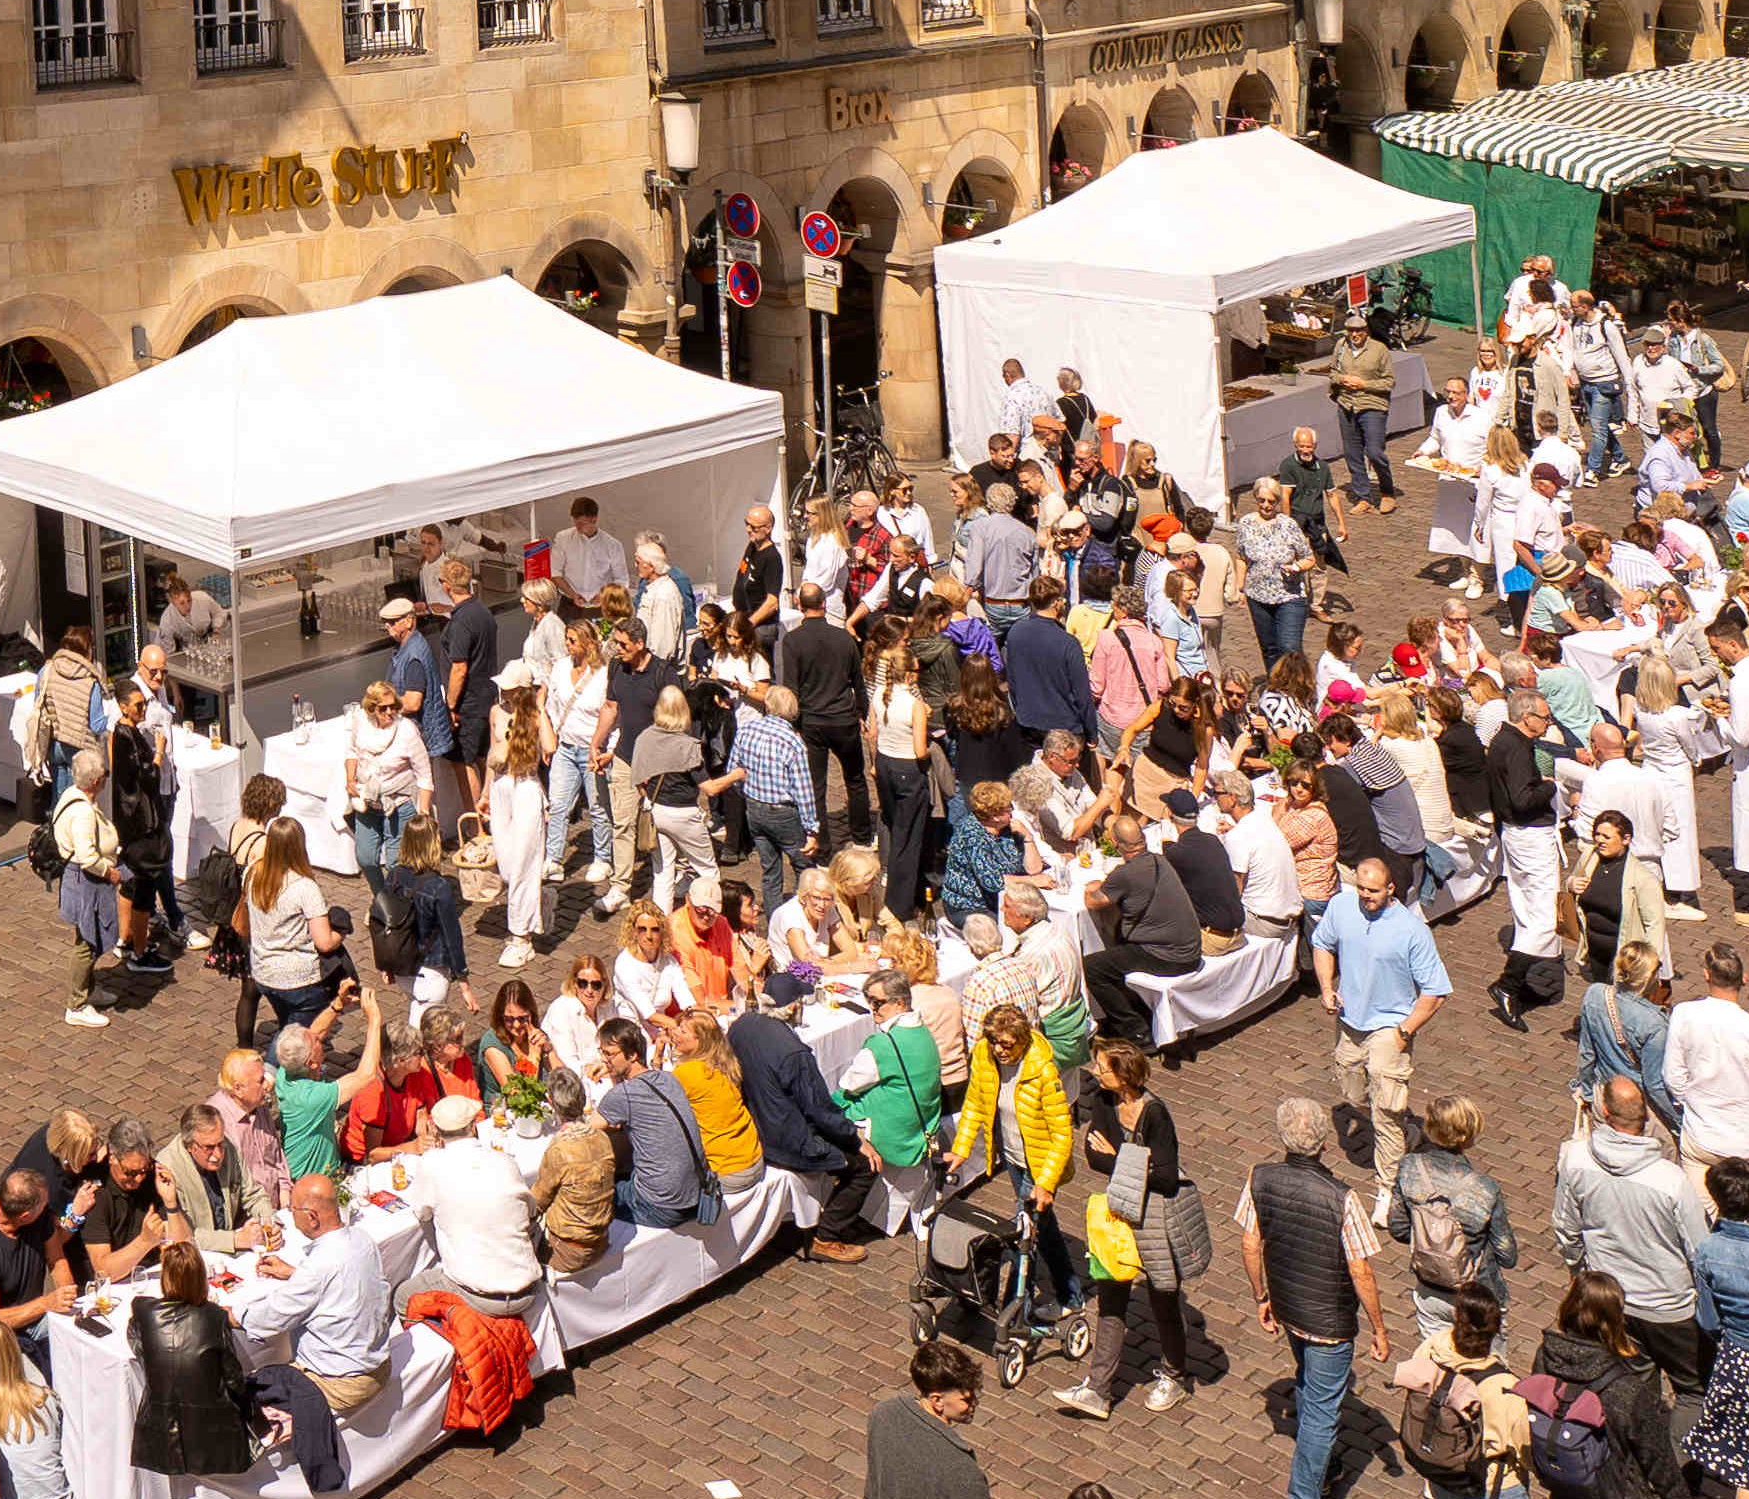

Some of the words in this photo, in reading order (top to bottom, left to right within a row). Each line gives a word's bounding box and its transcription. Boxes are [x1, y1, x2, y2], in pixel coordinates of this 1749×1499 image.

[1089, 32, 1168, 75] COUNTRY
[1172, 20, 1244, 61] CLASSICS
[825, 85, 894, 131] Brax
